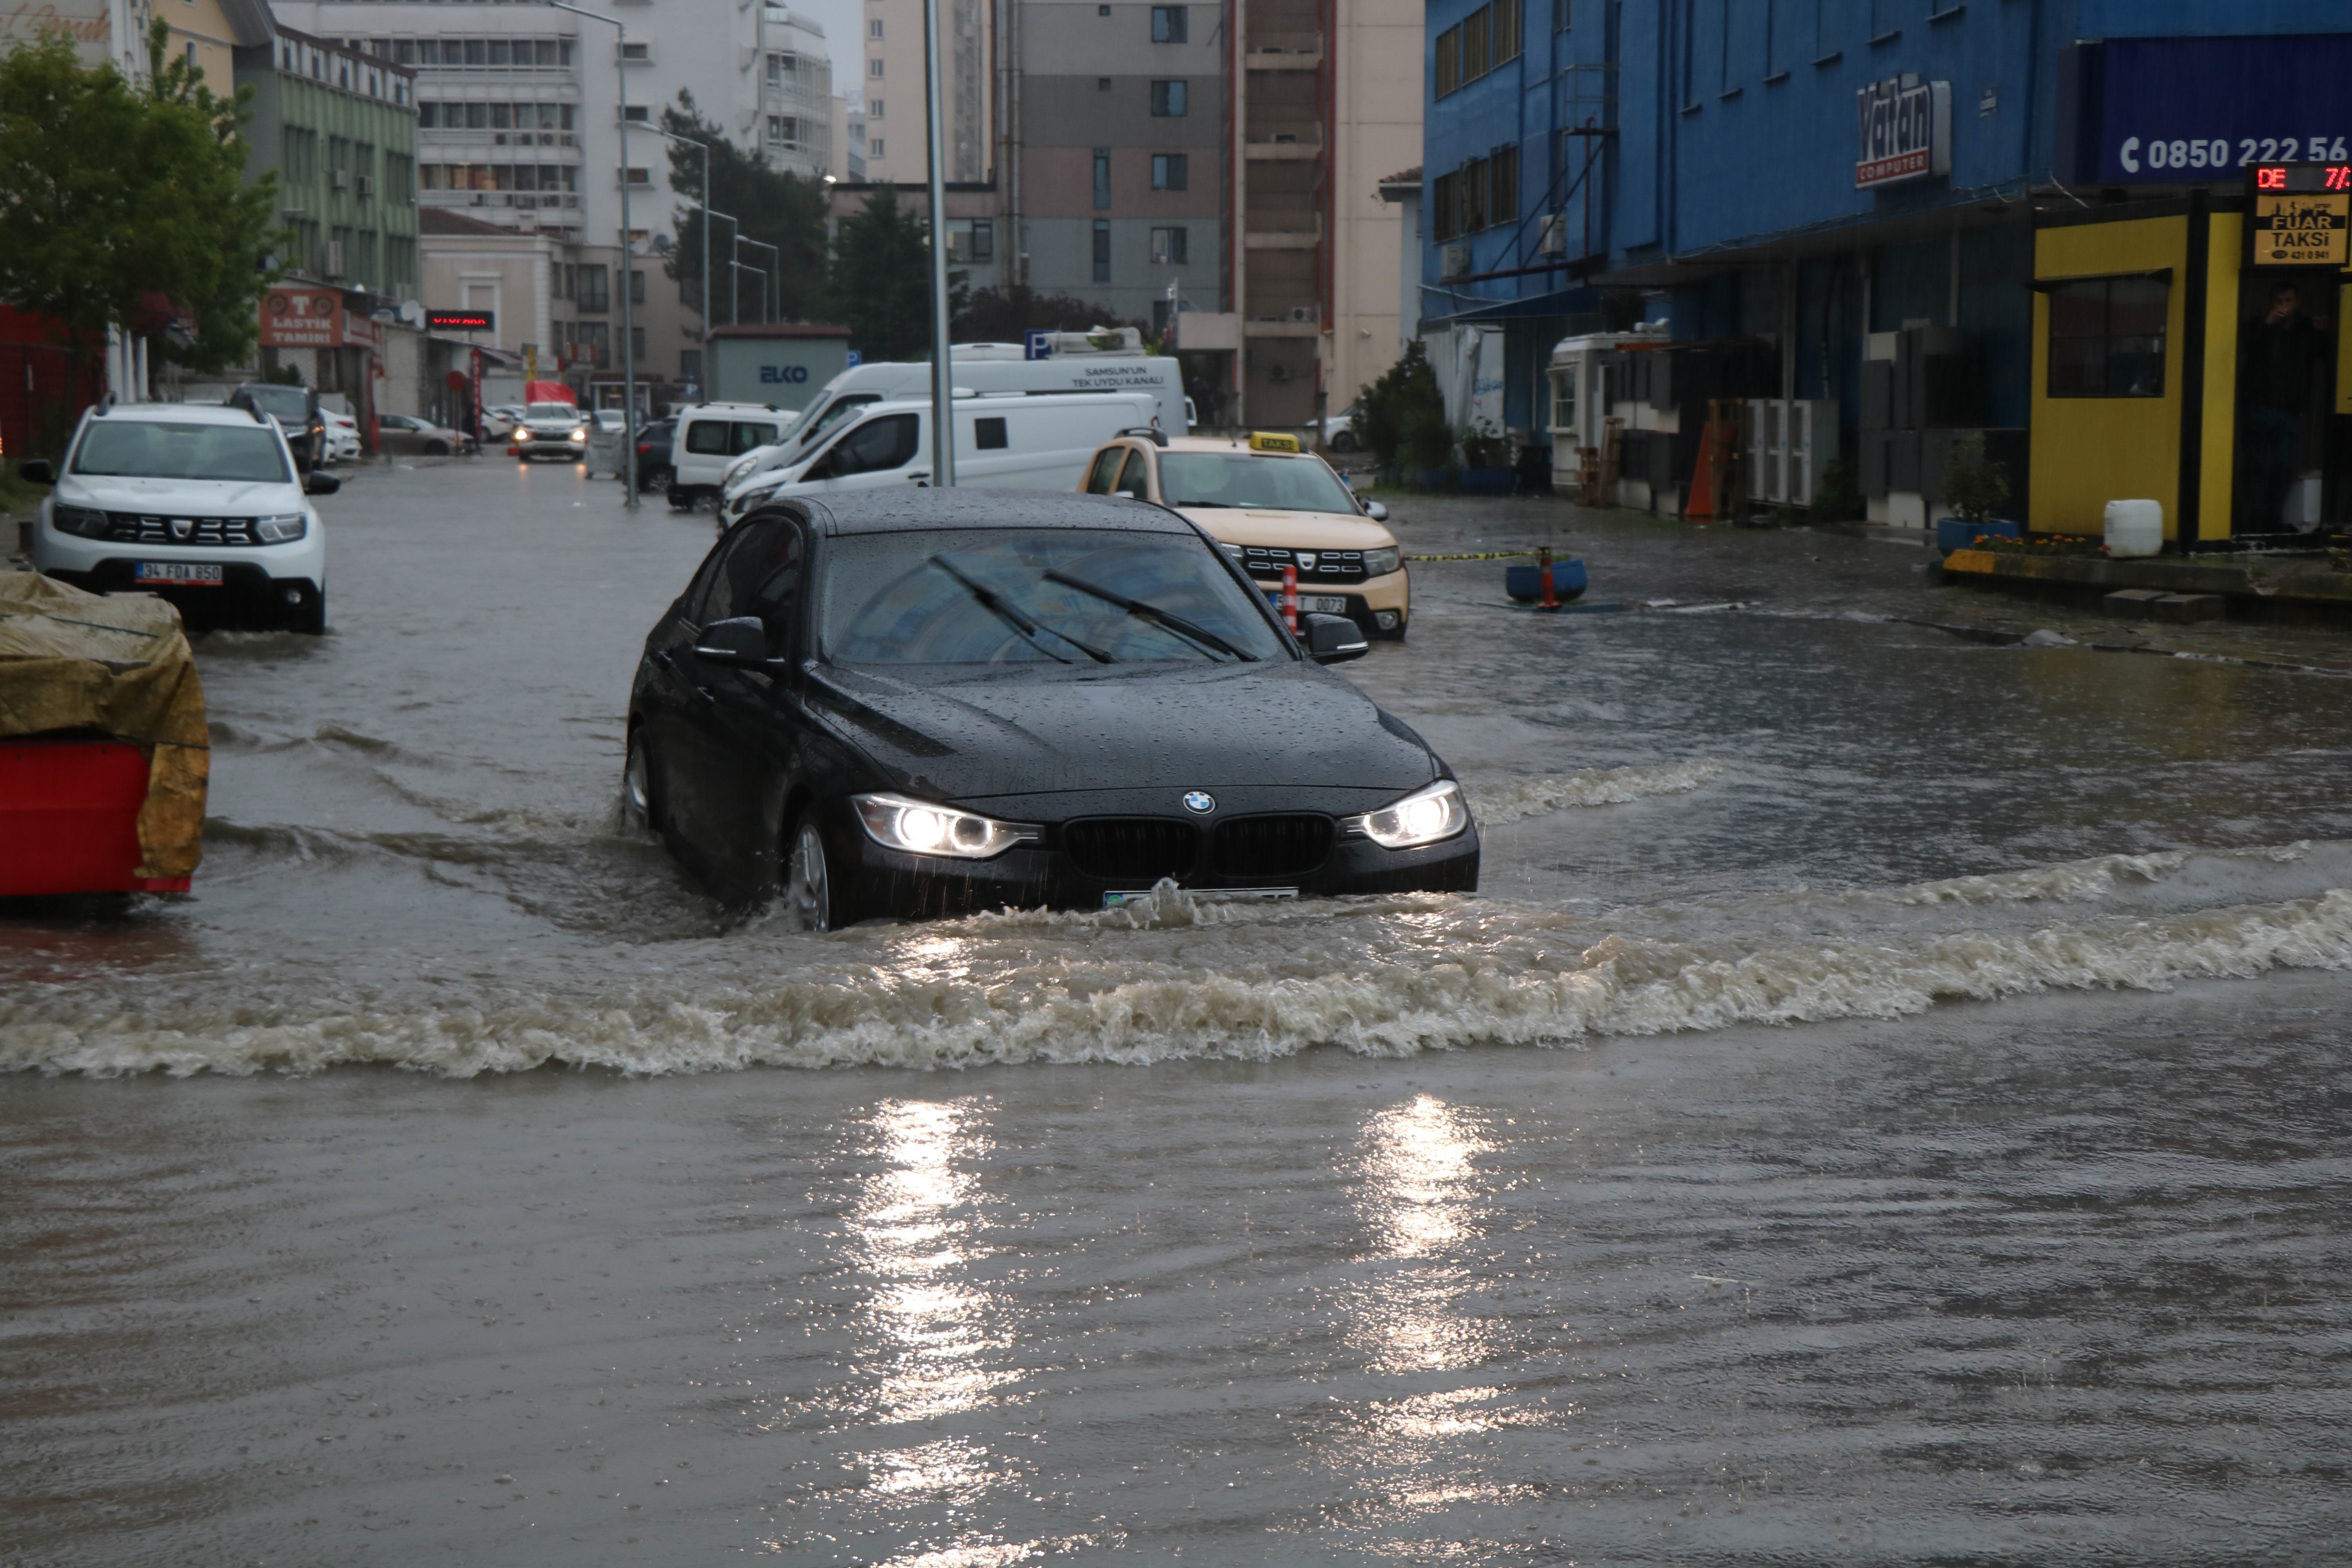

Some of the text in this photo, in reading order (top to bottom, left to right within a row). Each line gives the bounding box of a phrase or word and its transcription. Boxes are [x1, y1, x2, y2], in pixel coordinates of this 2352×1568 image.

[2149, 137, 2347, 168] 0850 222 56
[1859, 155, 1924, 180] COMPUTER
[2258, 169, 2286, 188] DE
[2272, 216, 2331, 229] FUAR
[2290, 251, 2304, 259] 431
[2315, 250, 2329, 259] 941
[292, 296, 309, 316] T
[1032, 334, 1049, 358] P
[760, 366, 808, 383] ELKO
[1085, 367, 1147, 376] SAMSUN'UN
[1073, 376, 1163, 387] TEK UYDU KANALI
[145, 564, 160, 577] 34
[196, 566, 220, 579] 850
[1300, 597, 1306, 610] T
[1317, 598, 1344, 612] 0073
